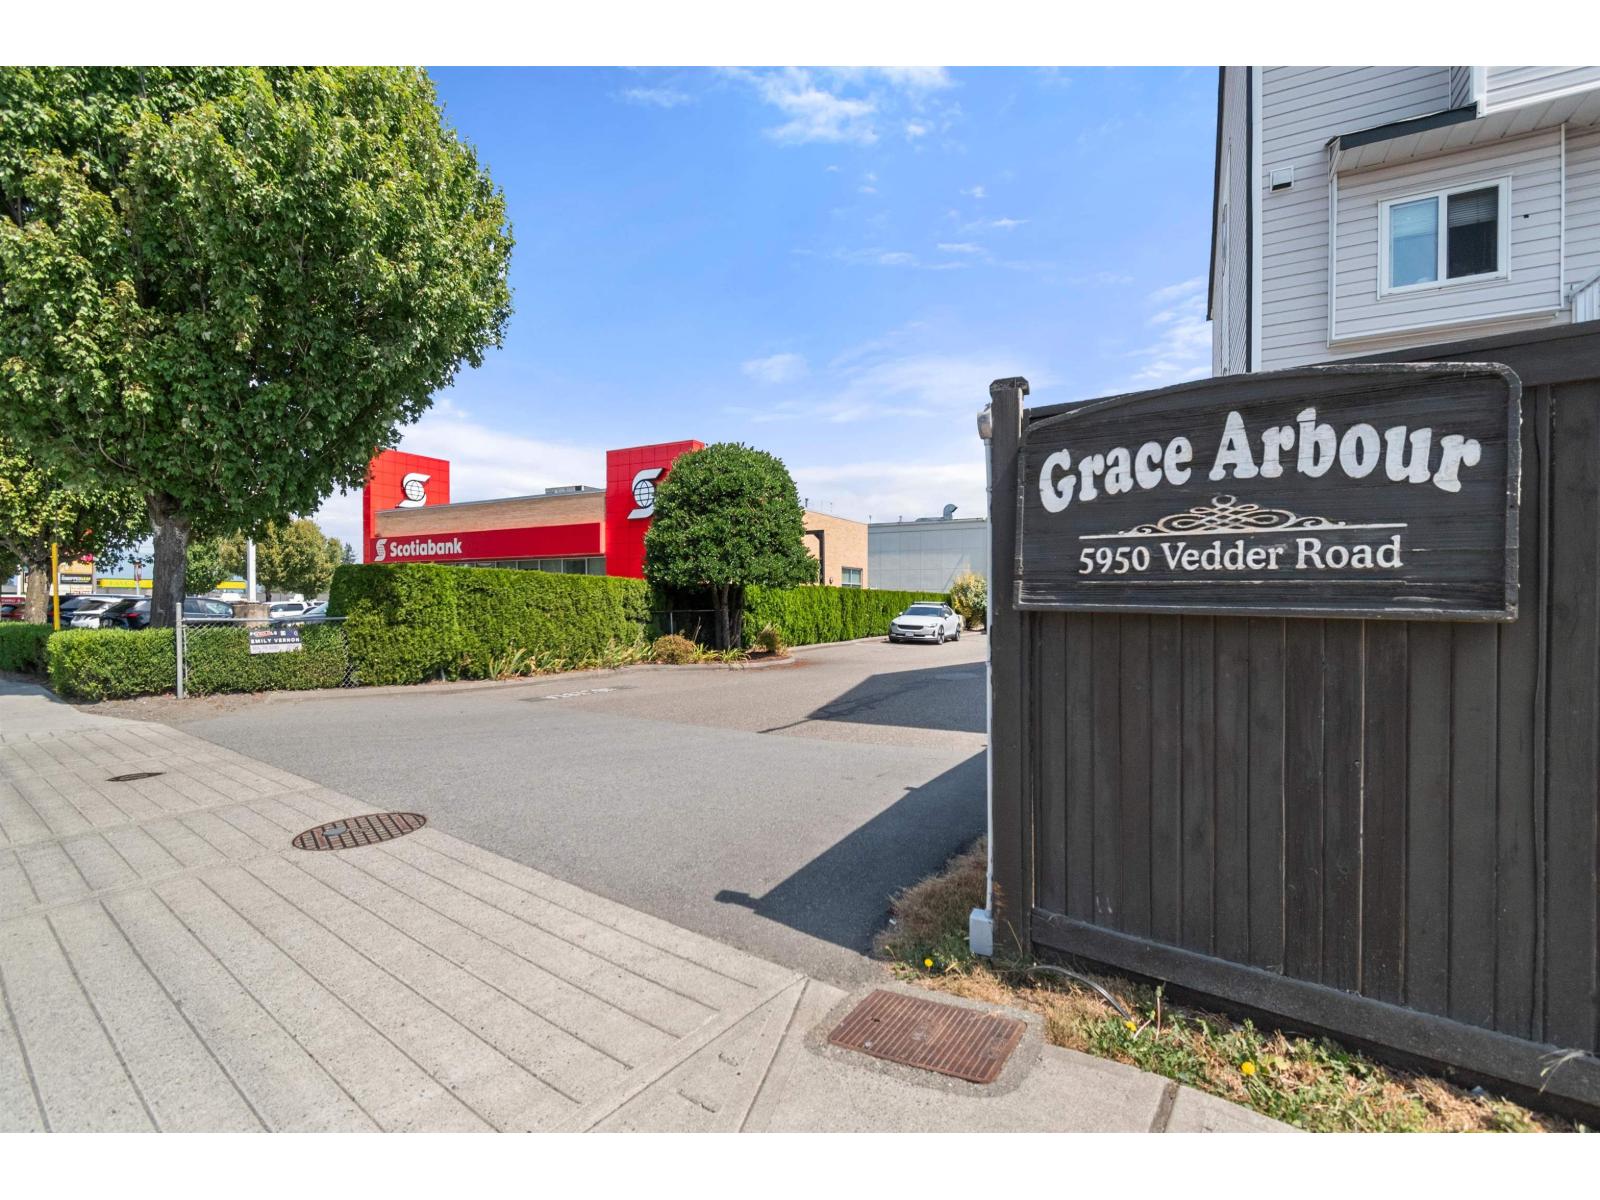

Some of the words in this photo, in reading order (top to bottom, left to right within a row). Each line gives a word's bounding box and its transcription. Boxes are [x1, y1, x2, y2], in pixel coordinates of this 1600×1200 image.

[1039, 436, 1193, 513] Grace
[1208, 407, 1481, 493] Arbour
[389, 537, 463, 557] Scotiabank
[1078, 547, 1150, 575] 5950
[1160, 540, 1284, 571] Vedder
[1295, 535, 1403, 569] Road
